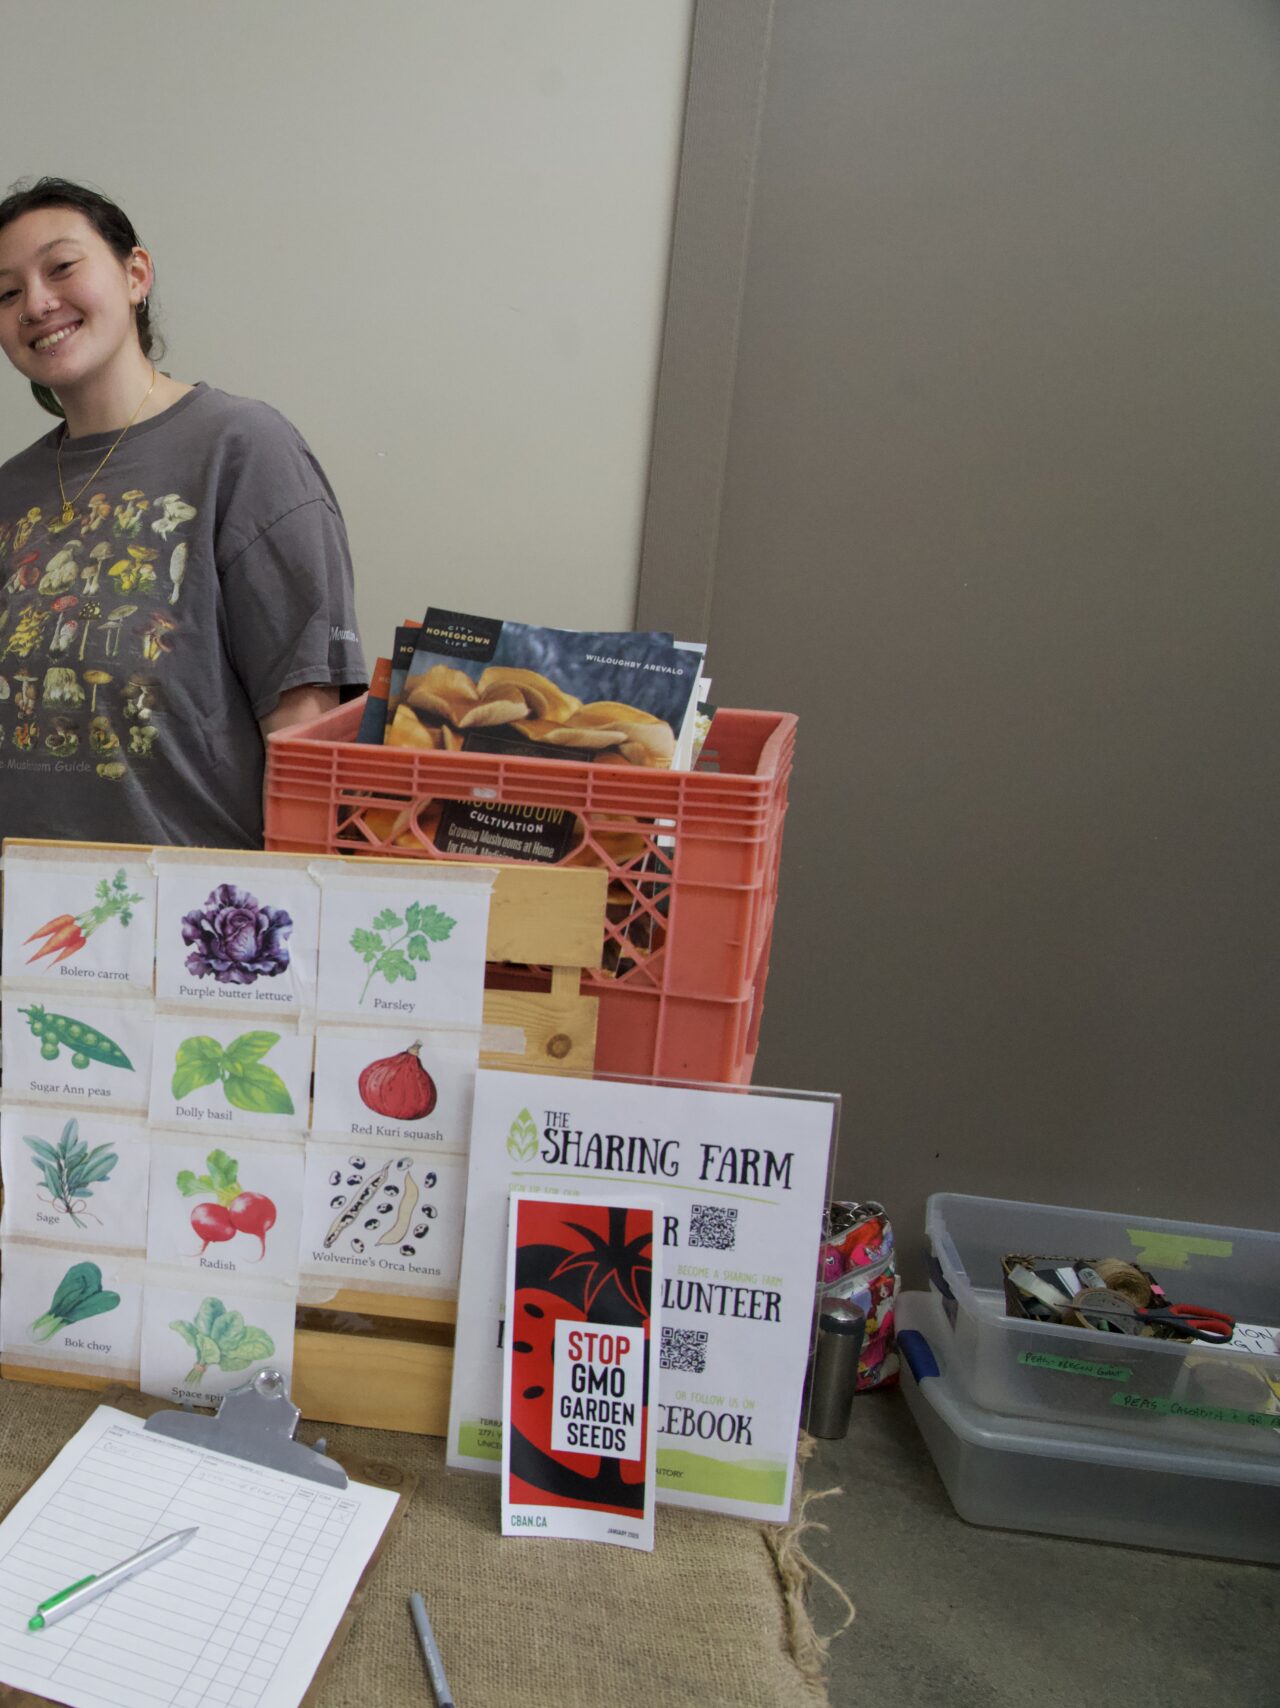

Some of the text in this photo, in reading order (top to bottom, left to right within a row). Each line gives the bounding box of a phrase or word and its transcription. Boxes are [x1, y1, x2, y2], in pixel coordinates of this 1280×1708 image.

[426, 627, 491, 645] HOMEGROWN
[447, 625, 473, 635] CITY
[445, 639, 469, 648] LIFE
[585, 653, 684, 676] WILLOUGHBY AREVALO
[55, 760, 92, 772] Guide
[469, 810, 544, 833] CULTIVATION
[448, 823, 480, 841] Growing
[480, 830, 522, 850] Mushrooms
[523, 842, 532, 853] at
[533, 842, 555, 859] Home
[59, 964, 130, 982] Bolero carrot
[178, 984, 294, 1003] Purple butter lettuce
[373, 997, 416, 1014] Parsley
[29, 1080, 112, 1099] Sugar Ann peas
[175, 1105, 233, 1122] Dolly basil
[544, 1110, 571, 1129] THE
[350, 1122, 444, 1143] Red Kuri squash
[540, 1128, 796, 1190] SHARING FARM
[36, 1211, 61, 1227] Sage
[199, 1257, 237, 1272] Radish
[311, 1250, 442, 1277] Wolverine's Orca beans
[677, 1263, 785, 1288] BECOME A SHARING FARM
[661, 1278, 782, 1323] LUNTEER
[64, 1337, 112, 1355] Bok choy
[568, 1330, 631, 1366] STOP
[571, 1363, 626, 1399] GMO
[171, 1386, 202, 1399] Space
[675, 1390, 687, 1401] OR
[691, 1392, 726, 1406] FOLLOW
[560, 1394, 635, 1428] GARDEN
[1124, 1395, 1157, 1410] PEAS
[657, 1403, 753, 1446] CEBOOK
[566, 1422, 627, 1452] SEEDS
[510, 1514, 548, 1529] CBAN.CA
